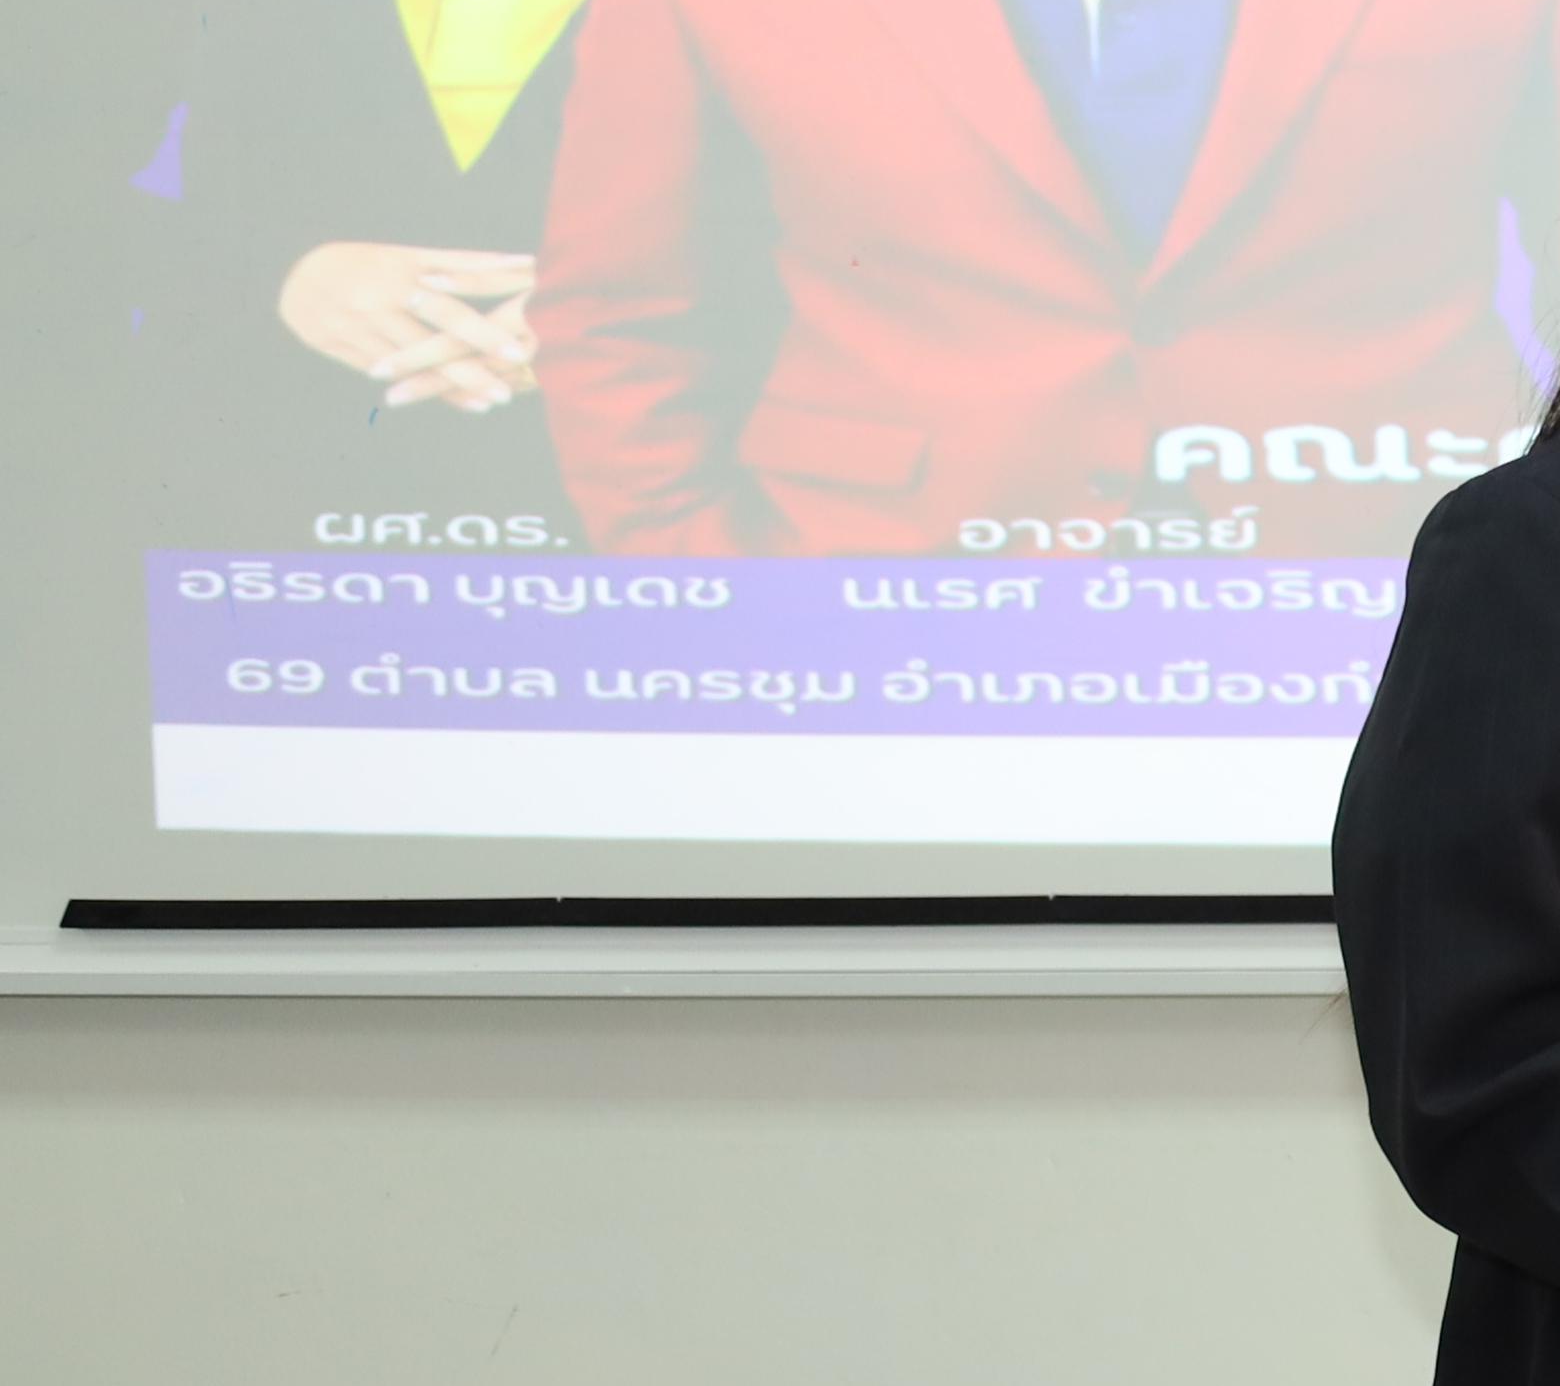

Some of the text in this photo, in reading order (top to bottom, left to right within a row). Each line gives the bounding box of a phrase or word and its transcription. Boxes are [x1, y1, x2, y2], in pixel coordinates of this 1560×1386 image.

[313, 511, 569, 547] ผศ.ดร.
[958, 505, 1259, 551] อาจารย์
[455, 574, 733, 619] บุญเดช
[842, 564, 1398, 620] นเรศ ขำเจริญ
[225, 657, 325, 694] 69
[349, 651, 557, 698] ตำบล
[583, 666, 855, 716] นครชุม
